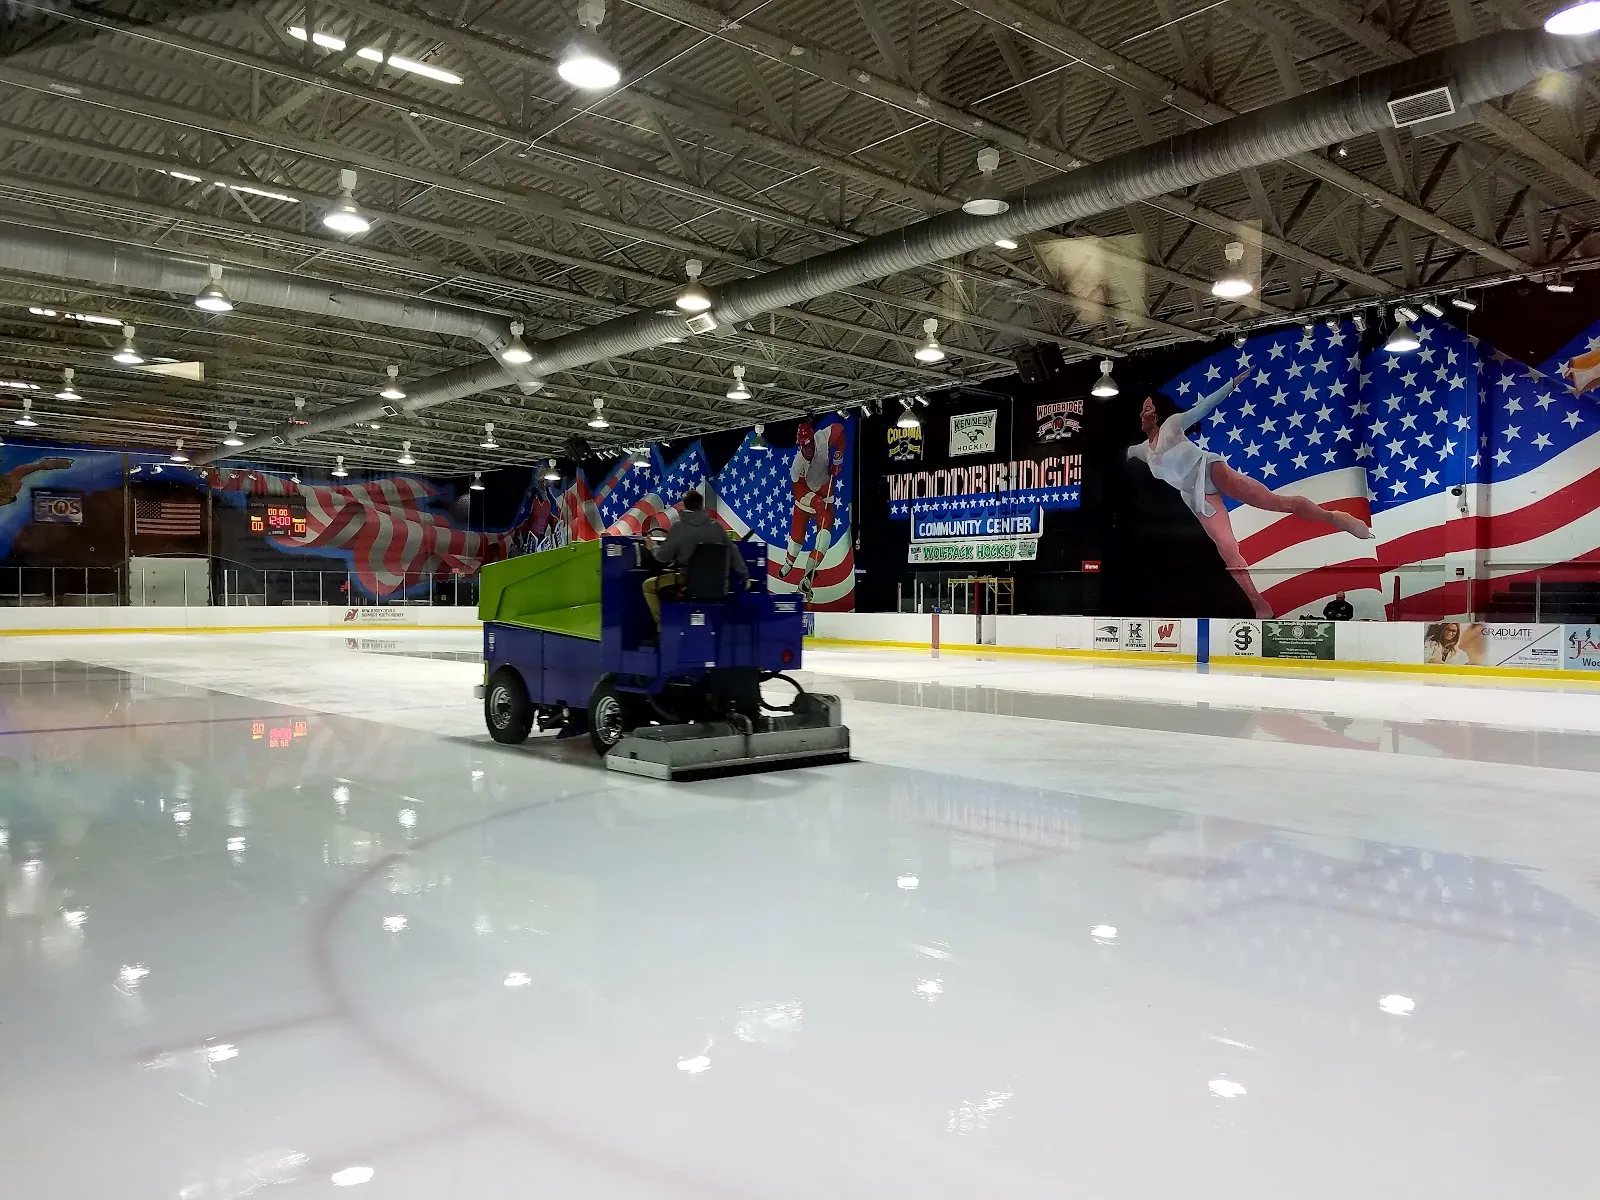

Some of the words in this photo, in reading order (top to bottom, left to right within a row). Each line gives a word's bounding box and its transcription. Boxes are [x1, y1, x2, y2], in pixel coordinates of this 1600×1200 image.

[1036, 400, 1084, 421] WOODBRIDGE
[954, 413, 994, 433] KENNEDY
[887, 426, 922, 444] COLONIA
[957, 442, 989, 452] HOCKEY
[887, 453, 1083, 502] WOODBRIDGE
[251, 521, 264, 531] 00
[269, 516, 291, 526] 12:00
[294, 523, 306, 533] 00
[919, 519, 982, 537] COMMUNITY
[986, 517, 1032, 534] CENTER
[923, 545, 974, 561] WOLFPACK
[976, 543, 1018, 559] HOCKEY
[1158, 623, 1175, 640] W
